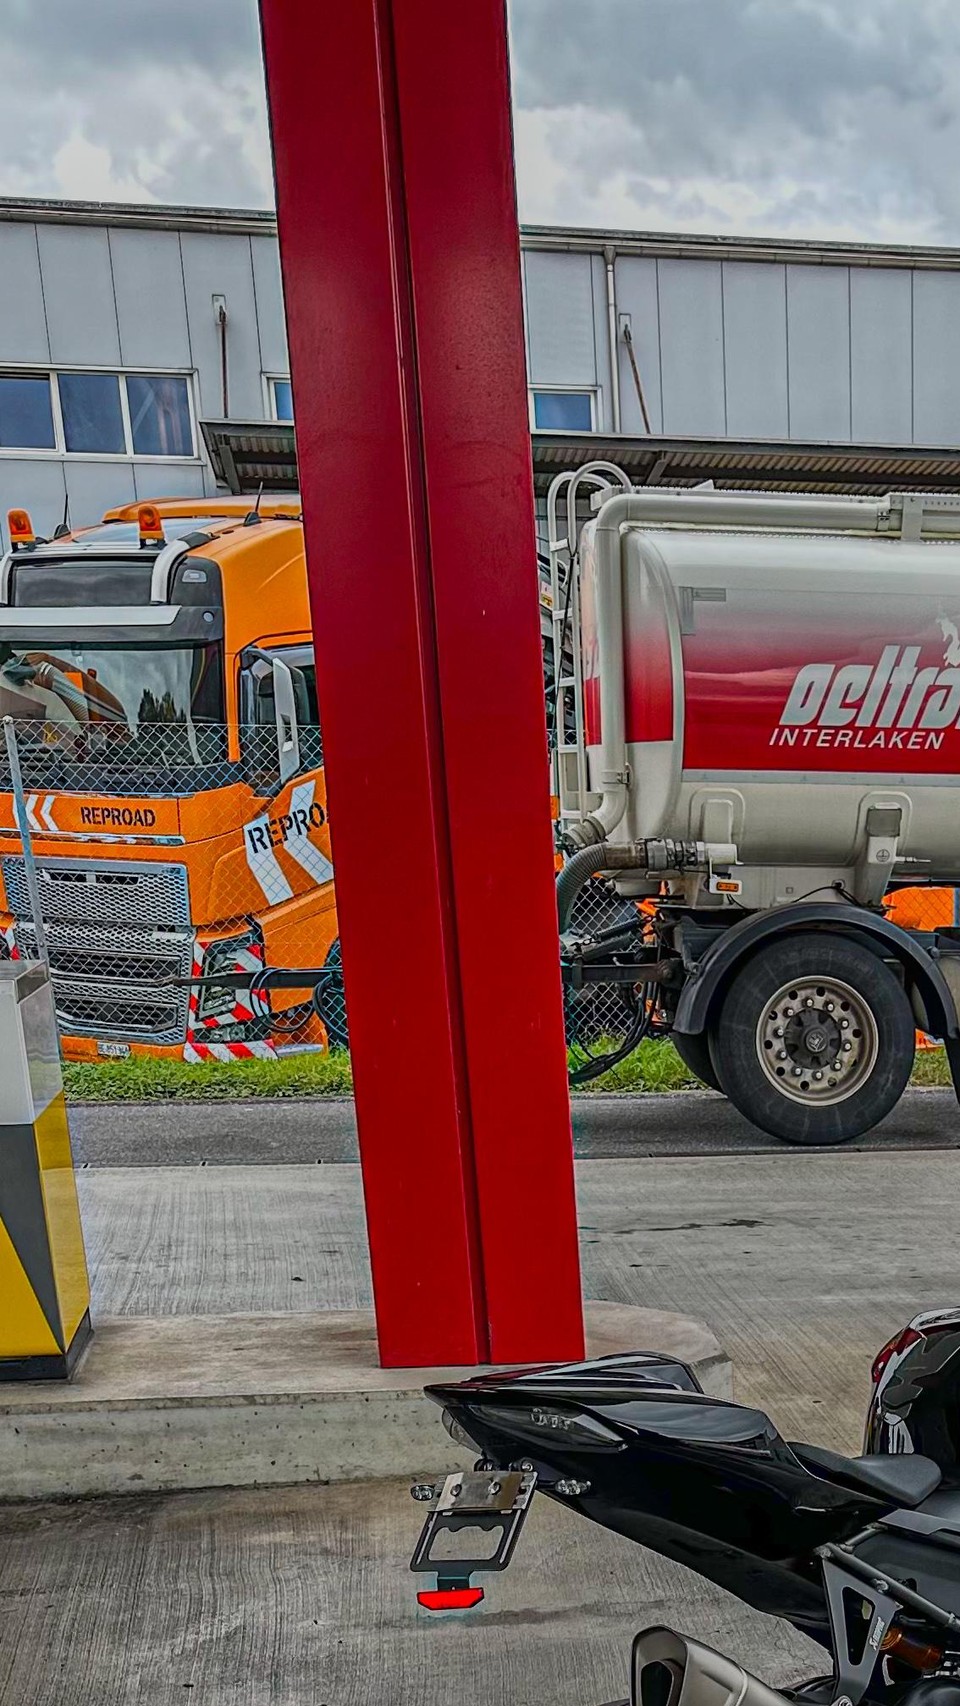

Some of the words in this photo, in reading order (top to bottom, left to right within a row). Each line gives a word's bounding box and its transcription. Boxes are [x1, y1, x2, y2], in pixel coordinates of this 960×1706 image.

[769, 728, 945, 750] INTERLAKEN
[80, 806, 156, 827] REPROAD
[247, 803, 325, 854] REPRO
